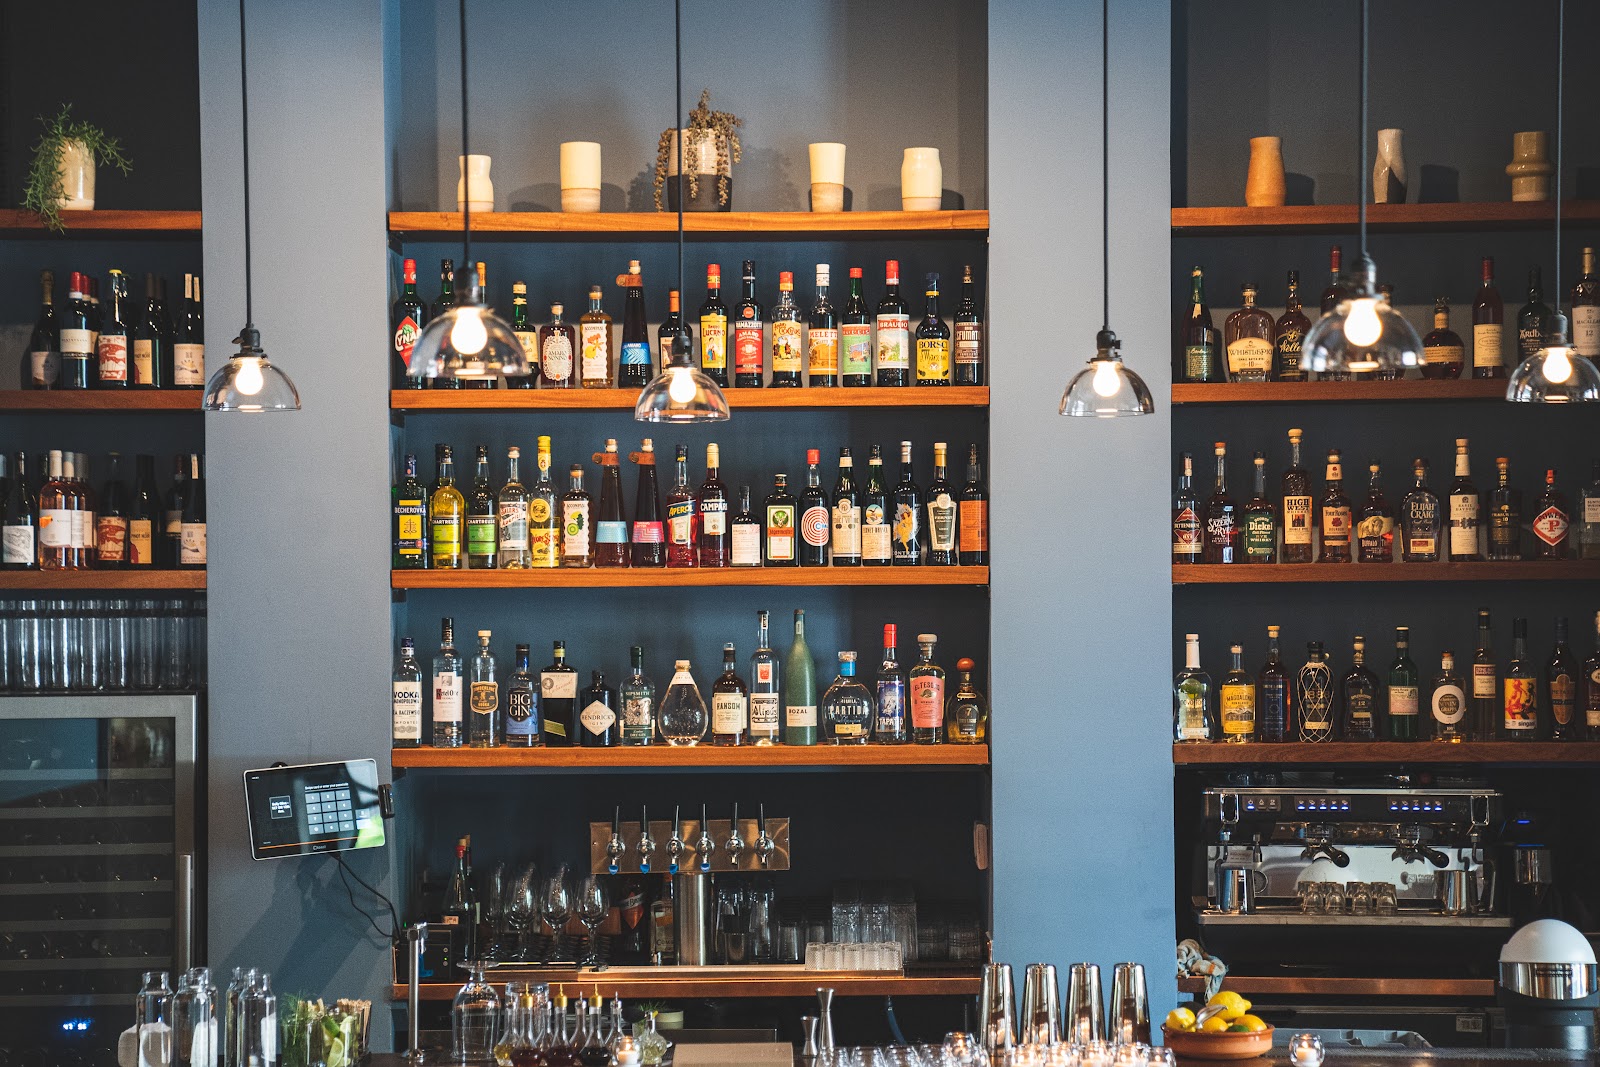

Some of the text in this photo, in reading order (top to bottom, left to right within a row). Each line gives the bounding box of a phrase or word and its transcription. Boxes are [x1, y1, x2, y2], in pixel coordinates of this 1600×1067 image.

[1288, 357, 1298, 365] 12
[668, 504, 694, 517] APEROL
[700, 503, 728, 511] CAMPARI
[1411, 502, 1435, 511] ELIJAH
[1410, 509, 1434, 520] CRAIG
[1248, 521, 1274, 531] Dickel
[1548, 519, 1560, 533] P
[510, 693, 531, 705] BIG
[509, 704, 531, 717] GIN
[716, 702, 741, 710] RANSOM
